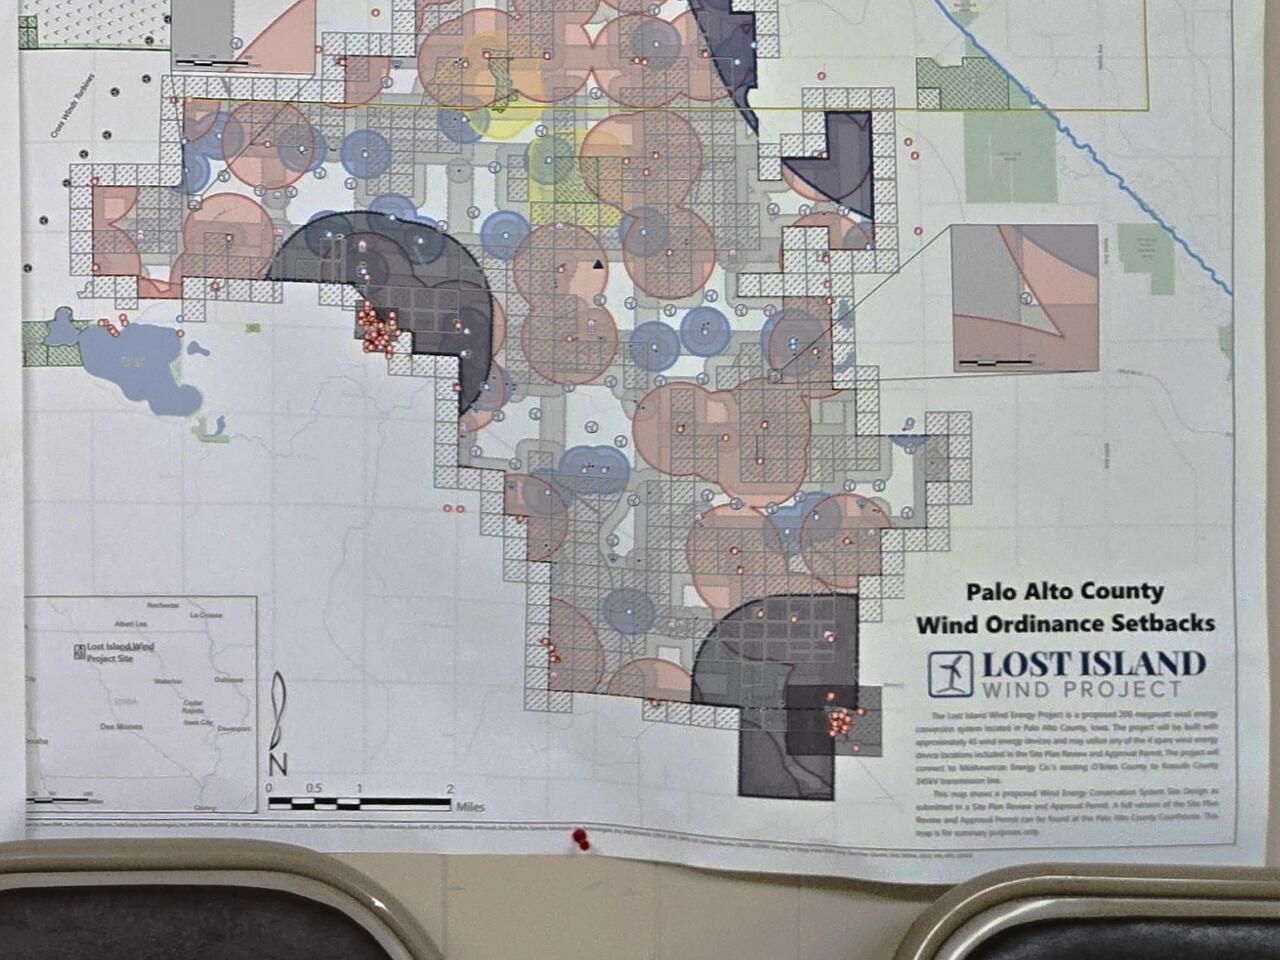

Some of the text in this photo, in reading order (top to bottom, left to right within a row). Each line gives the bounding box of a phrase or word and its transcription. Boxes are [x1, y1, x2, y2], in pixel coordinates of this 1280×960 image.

[967, 581, 1165, 605] Palo Alto County
[916, 612, 1216, 634] Wind Ordinance Setbacks
[982, 650, 1207, 677] LOST ISLAND
[981, 680, 1183, 699] WIND PROJECT
